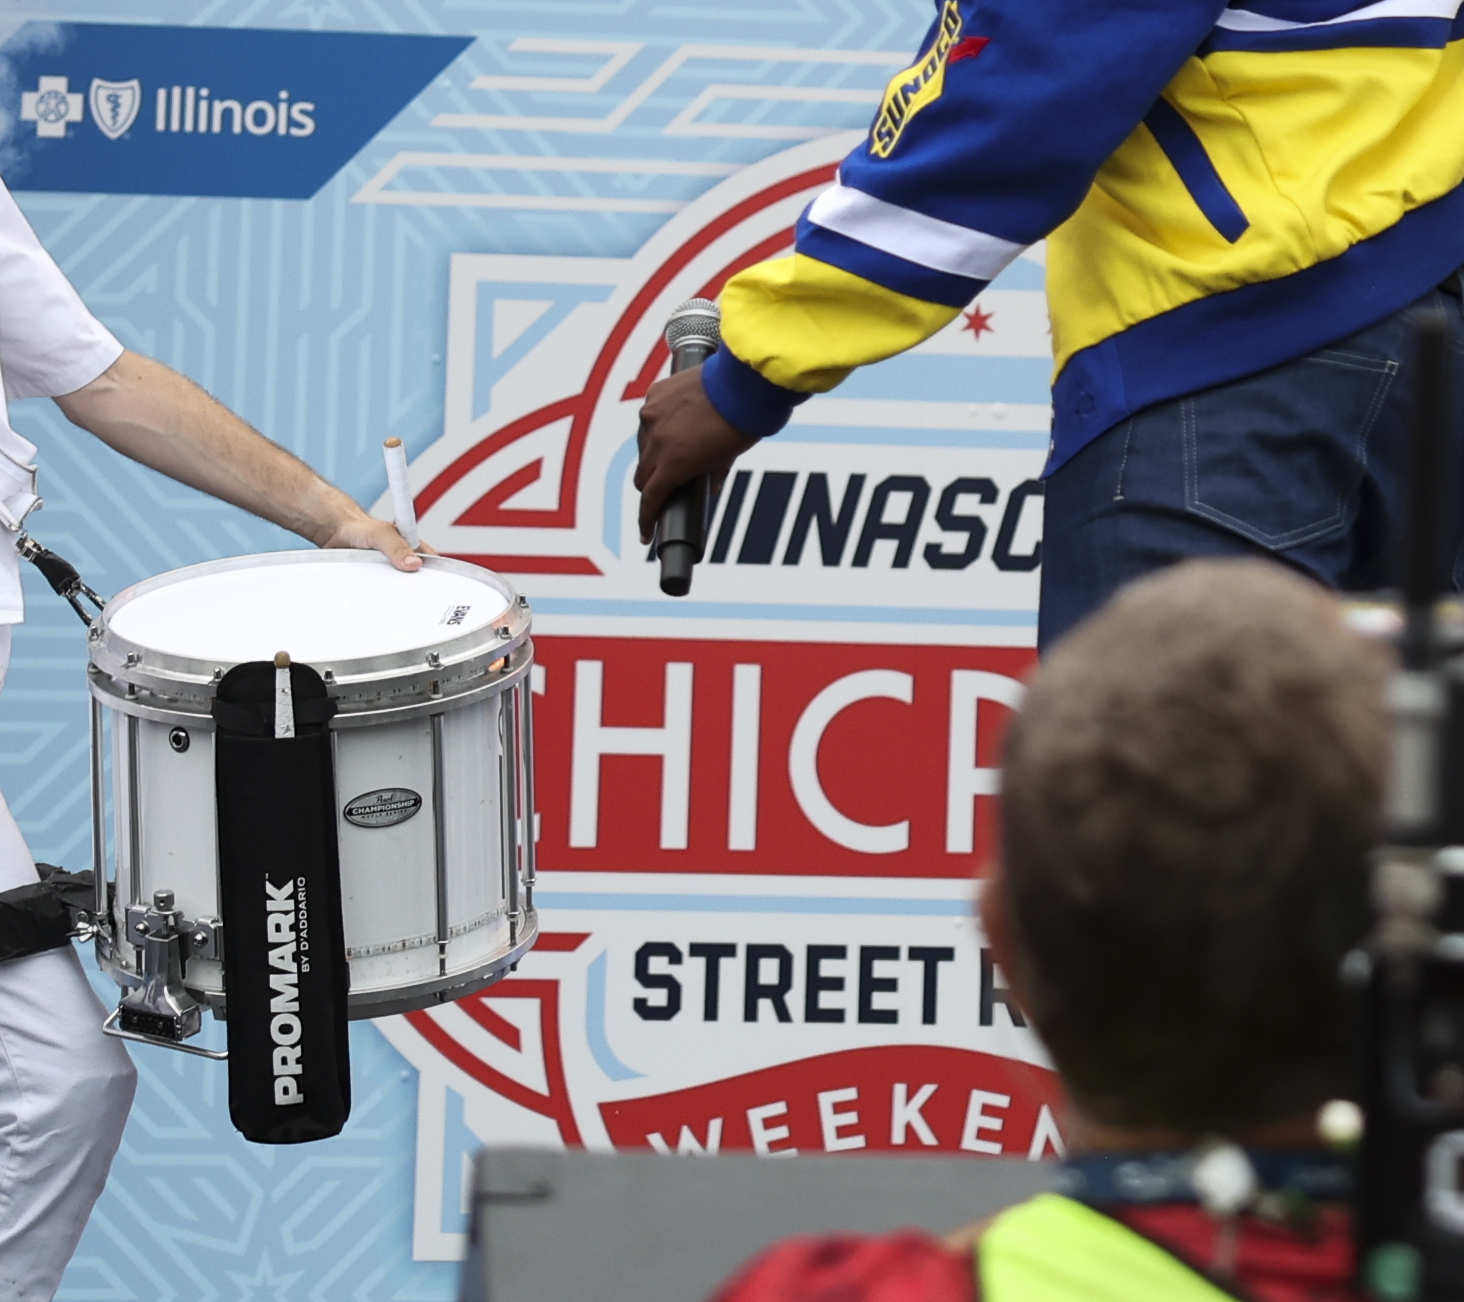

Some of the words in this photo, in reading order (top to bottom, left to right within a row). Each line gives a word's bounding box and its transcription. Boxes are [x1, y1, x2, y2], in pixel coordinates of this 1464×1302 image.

[155, 86, 316, 138] Illinois
[351, 798, 416, 816] CHAMPIONSHIP
[296, 875, 310, 951] D'ADDARIO
[265, 878, 304, 1106] PROMARK
[300, 954, 311, 974] BY
[632, 940, 956, 1025] STREET
